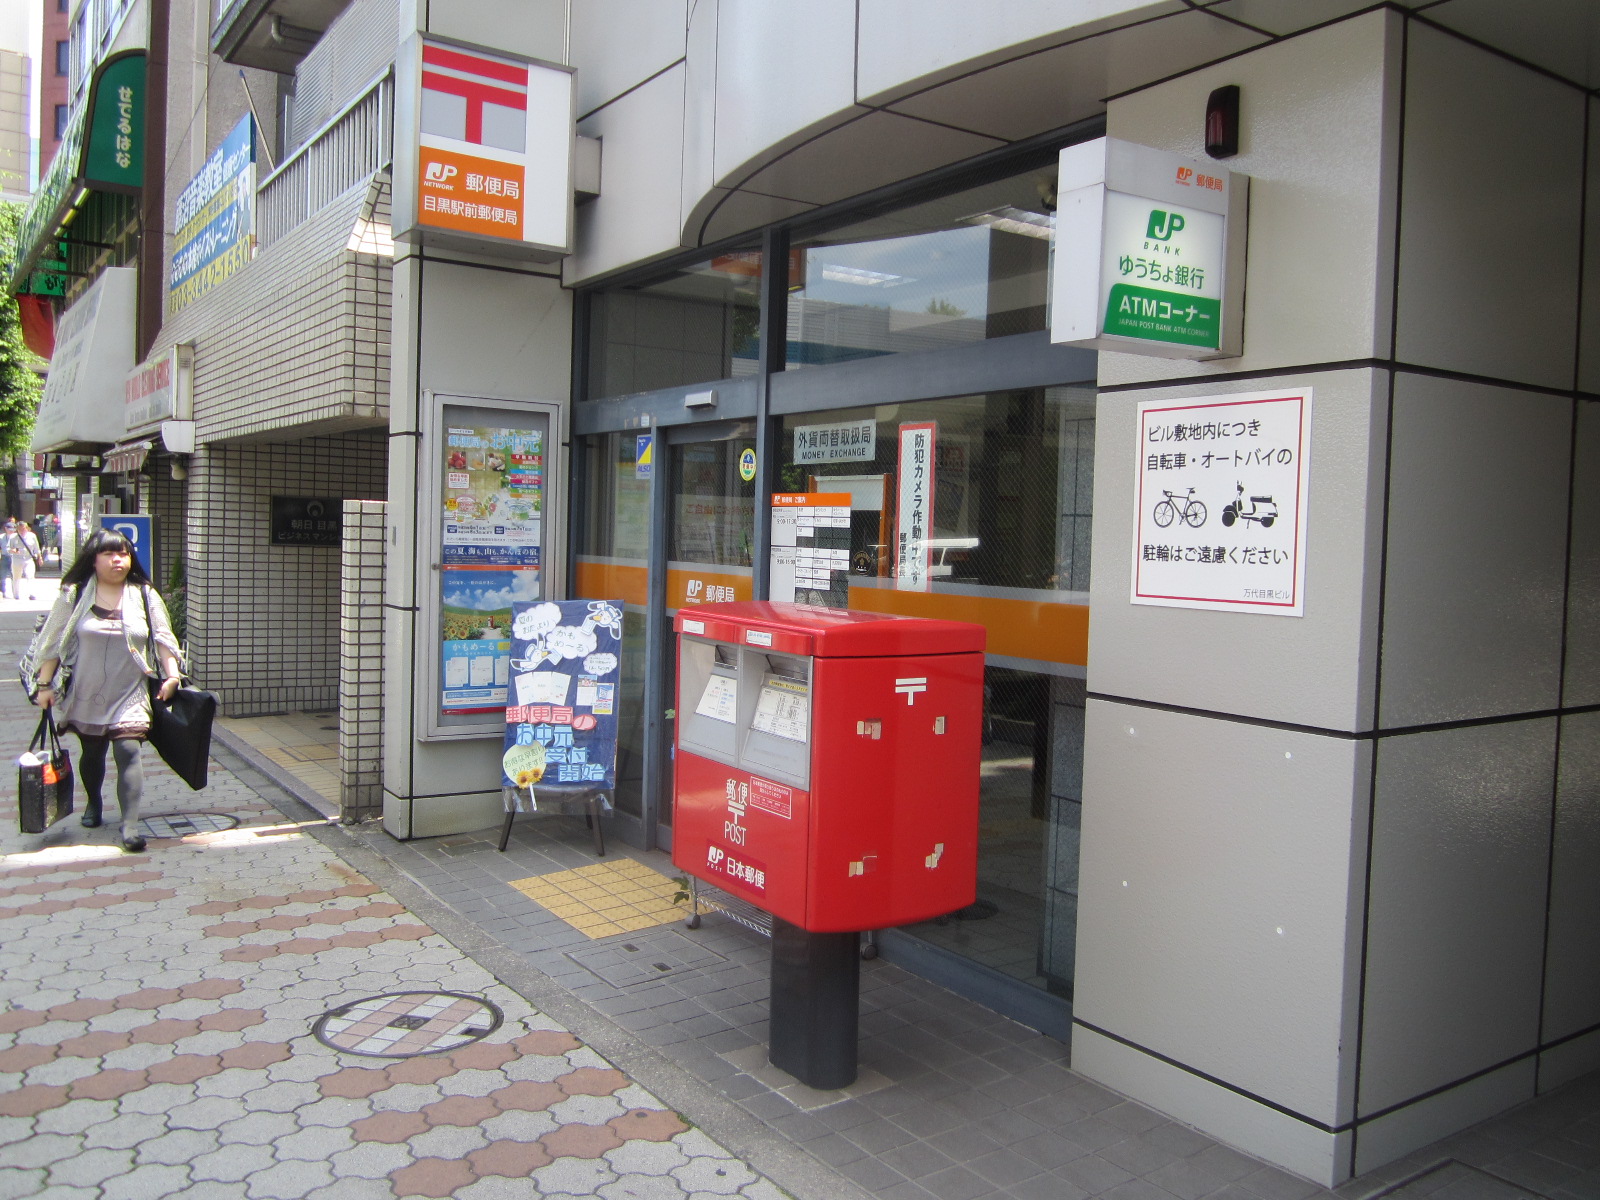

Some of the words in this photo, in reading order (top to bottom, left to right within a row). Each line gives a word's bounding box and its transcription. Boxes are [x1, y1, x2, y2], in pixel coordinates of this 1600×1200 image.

[425, 162, 458, 182] JP
[1196, 174, 1223, 192] 郵便局
[424, 181, 454, 191] NETWORK
[465, 173, 520, 200] 郵便局
[424, 195, 518, 225] 目黒駅前郵便局
[1146, 209, 1185, 242] JP
[1143, 242, 1181, 256] BANK
[1119, 255, 1204, 290] ゆうちょ銀行
[1119, 295, 1210, 323] ATMコーナー
[1119, 318, 1138, 327] JAPAN
[1140, 321, 1154, 330] POST
[1156, 323, 1172, 332] BANK
[1173, 326, 1187, 334] ATM
[1187, 328, 1210, 337] CORNER
[798, 425, 871, 449] 外貨両替取扱局
[1148, 418, 1261, 442] ビル敷地内につき
[802, 450, 825, 460] MONEY
[830, 447, 866, 458] EXCHANGE
[1147, 448, 1293, 471] 自転車・オートバイの
[1142, 544, 1289, 566] 駐輪はご遠慮ください
[687, 579, 703, 597] JP
[706, 585, 735, 603] 郵便局
[556, 630, 576, 640] かも
[506, 706, 597, 731] 郵便局の
[516, 723, 574, 748] お中元
[545, 747, 589, 764] 受付
[558, 763, 606, 783] 開始
[726, 778, 748, 806] 郵便
[724, 821, 747, 847] POST
[706, 861, 723, 873] POST
[727, 856, 765, 890] 日本郵便
